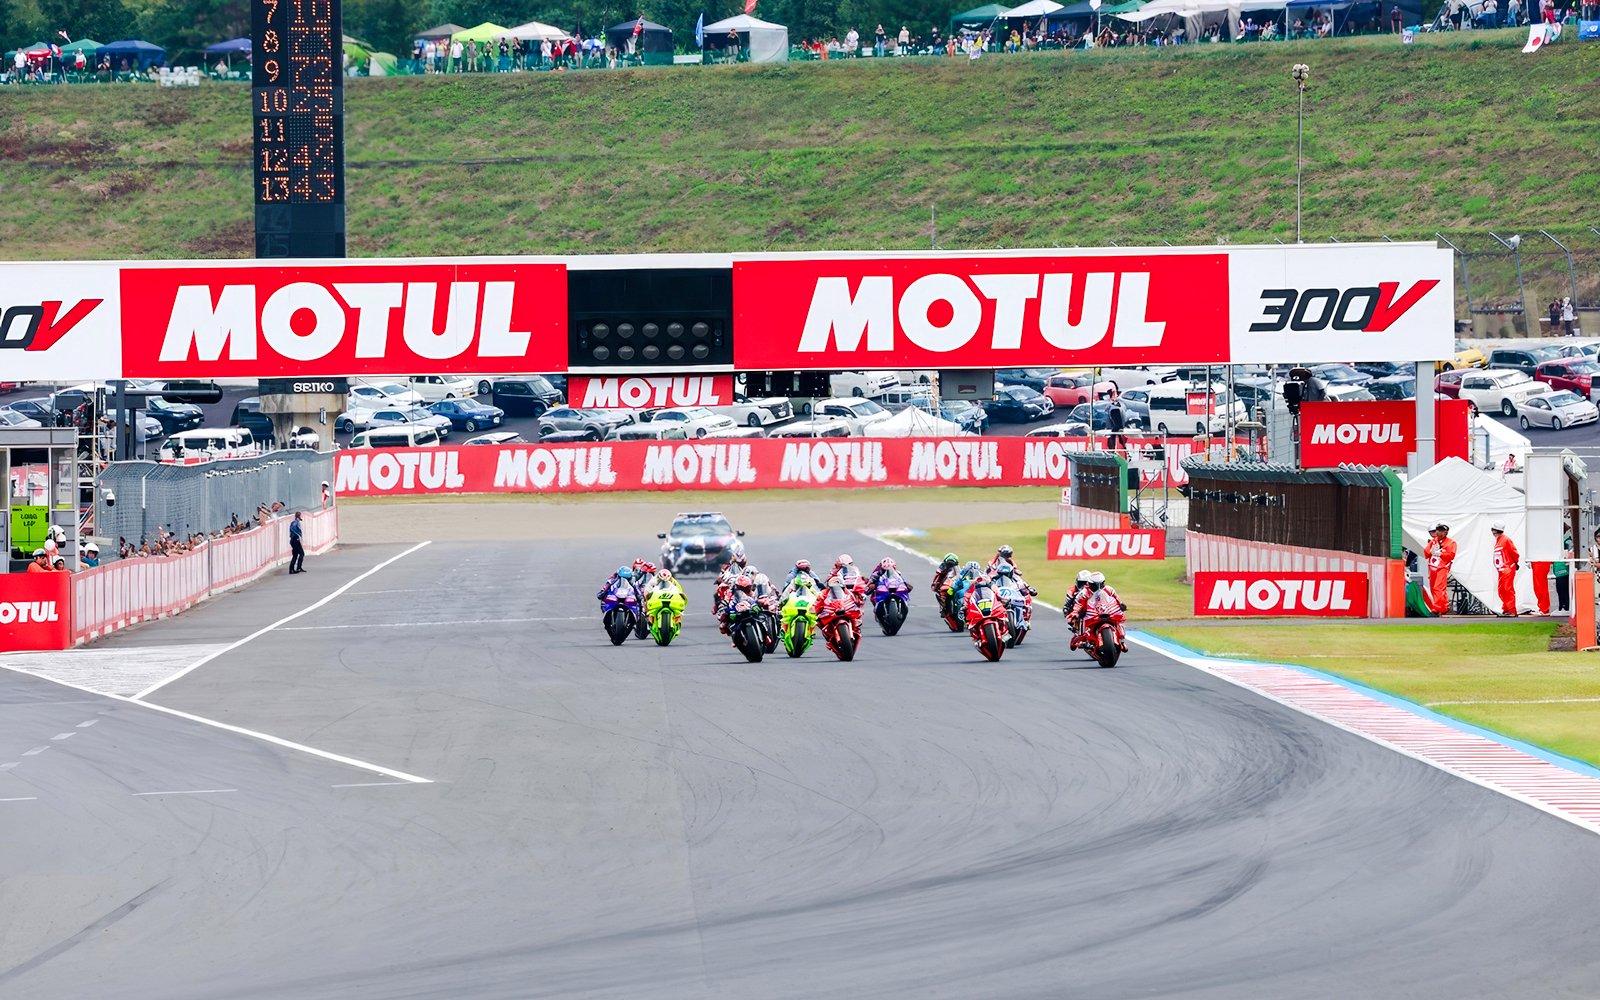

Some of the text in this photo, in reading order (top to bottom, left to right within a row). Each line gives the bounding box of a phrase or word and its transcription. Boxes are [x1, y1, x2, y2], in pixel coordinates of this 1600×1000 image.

[263, 0, 278, 23] 7
[263, 27, 332, 52] 8 73
[265, 60, 279, 82] 9
[261, 86, 333, 112] 10 25
[261, 115, 334, 141] 11 5
[261, 148, 289, 171] 12
[262, 174, 335, 200] 13 43
[798, 272, 1166, 352] MOTUL
[1249, 279, 1441, 332] 300V
[0, 298, 104, 352] 0V
[159, 282, 532, 361] MOTUL
[293, 382, 335, 393] SEIKO
[582, 377, 720, 408] MOTUL
[1311, 423, 1404, 445] MOTUL
[335, 451, 465, 492] MOTUL
[493, 446, 617, 488] MOTUL
[642, 443, 756, 485] MOTUL
[779, 440, 887, 482] MOTUL
[908, 440, 1003, 481] MOTUL
[1057, 533, 1155, 557] MOTUL
[1208, 579, 1352, 610] MOTUL
